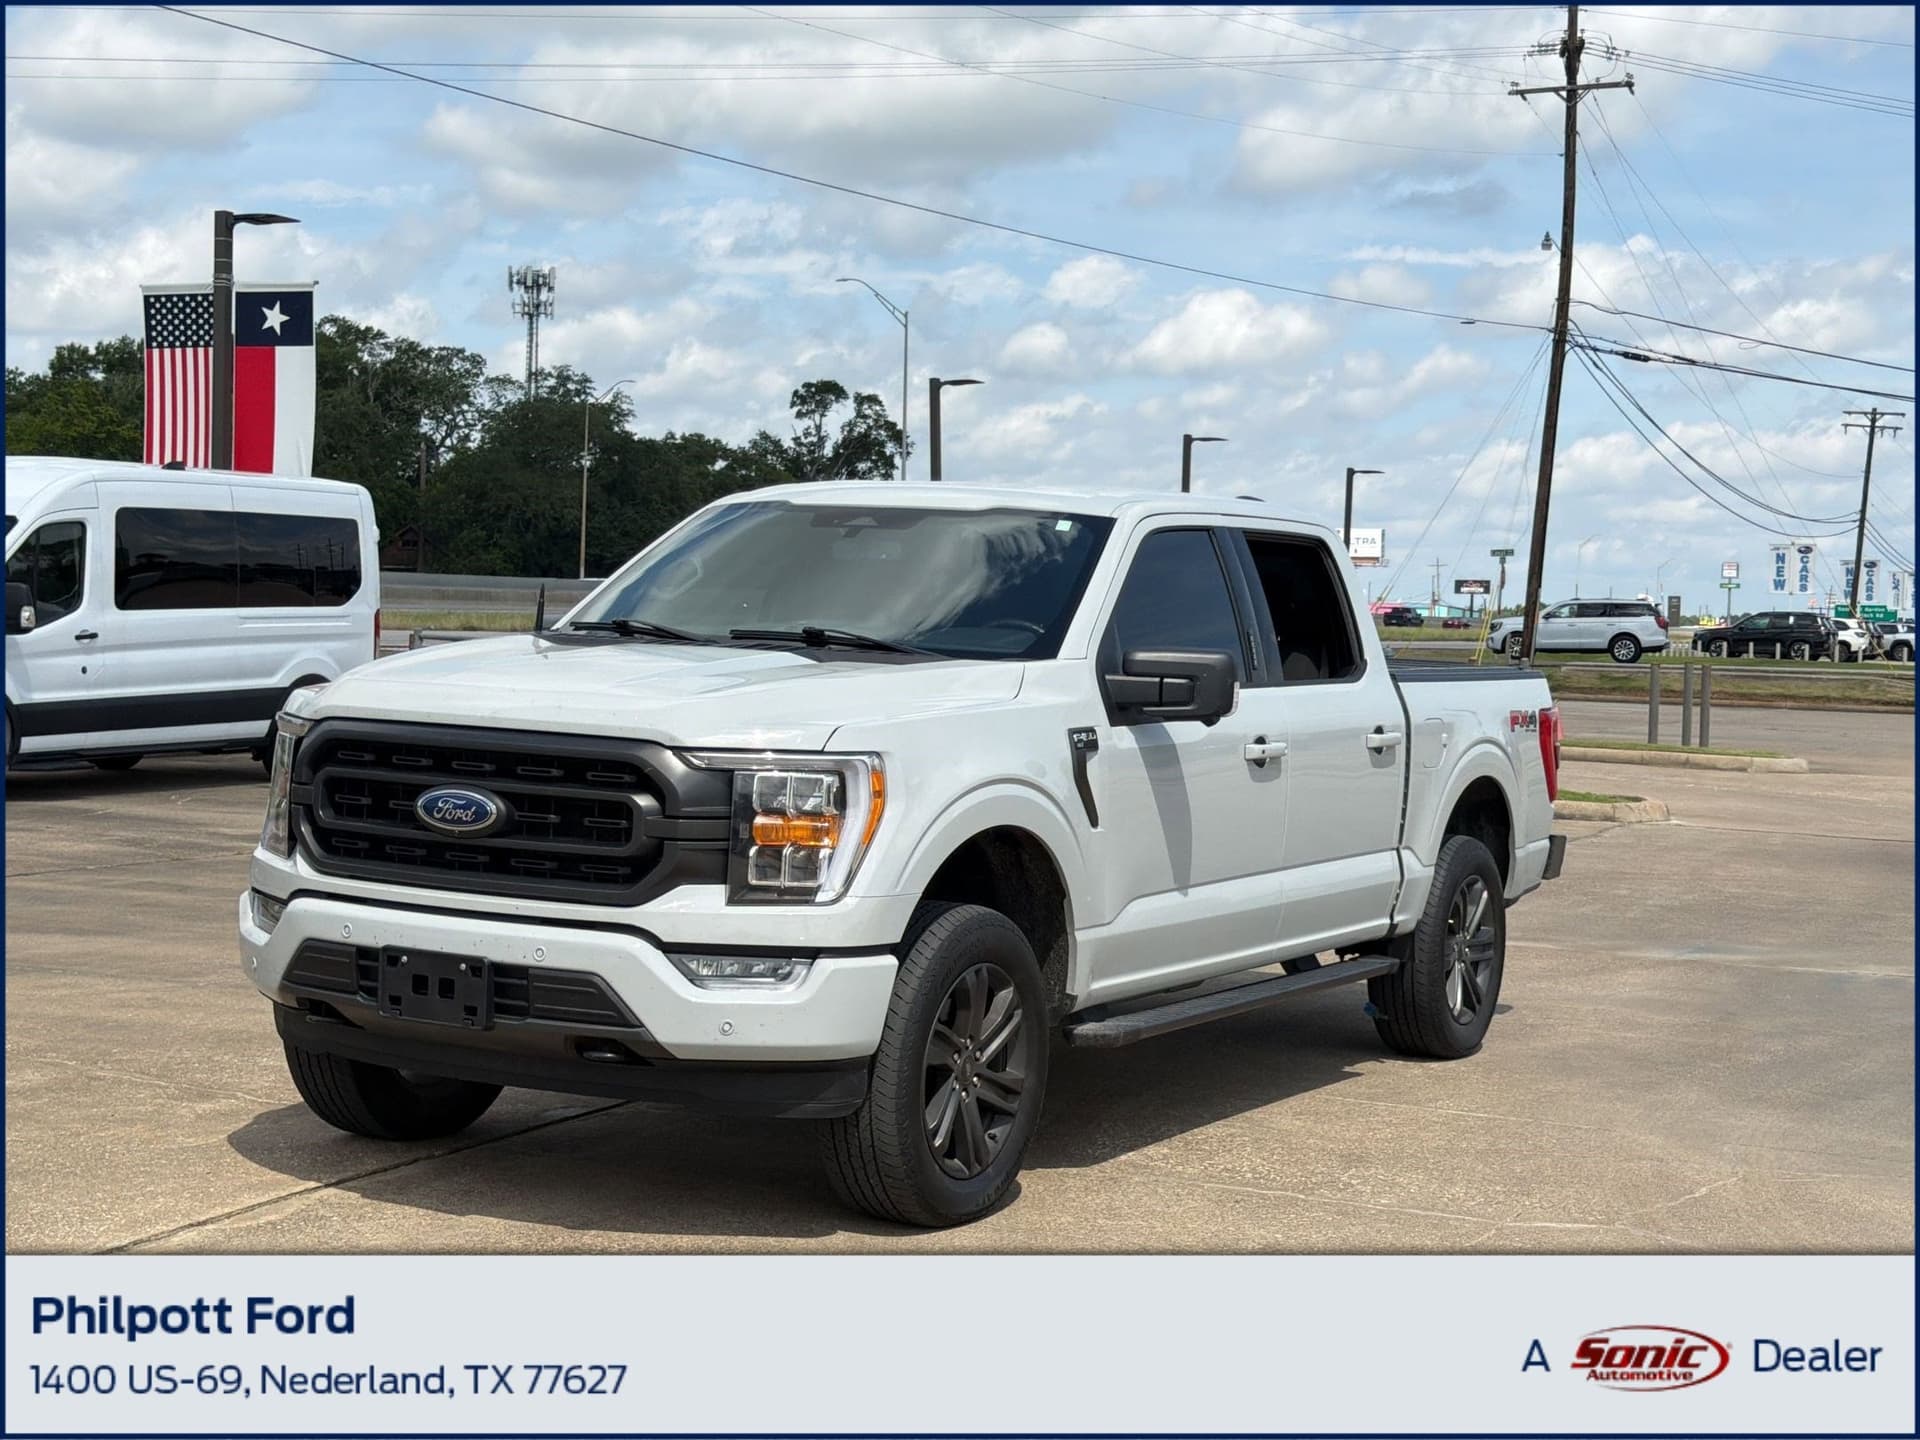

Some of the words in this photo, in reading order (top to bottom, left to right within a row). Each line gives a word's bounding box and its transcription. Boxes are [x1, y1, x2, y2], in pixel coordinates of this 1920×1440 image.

[1773, 552, 1786, 591] NEW
[1799, 555, 1809, 592] CARS
[1865, 570, 1874, 601] CARS
[433, 797, 477, 822] Ford
